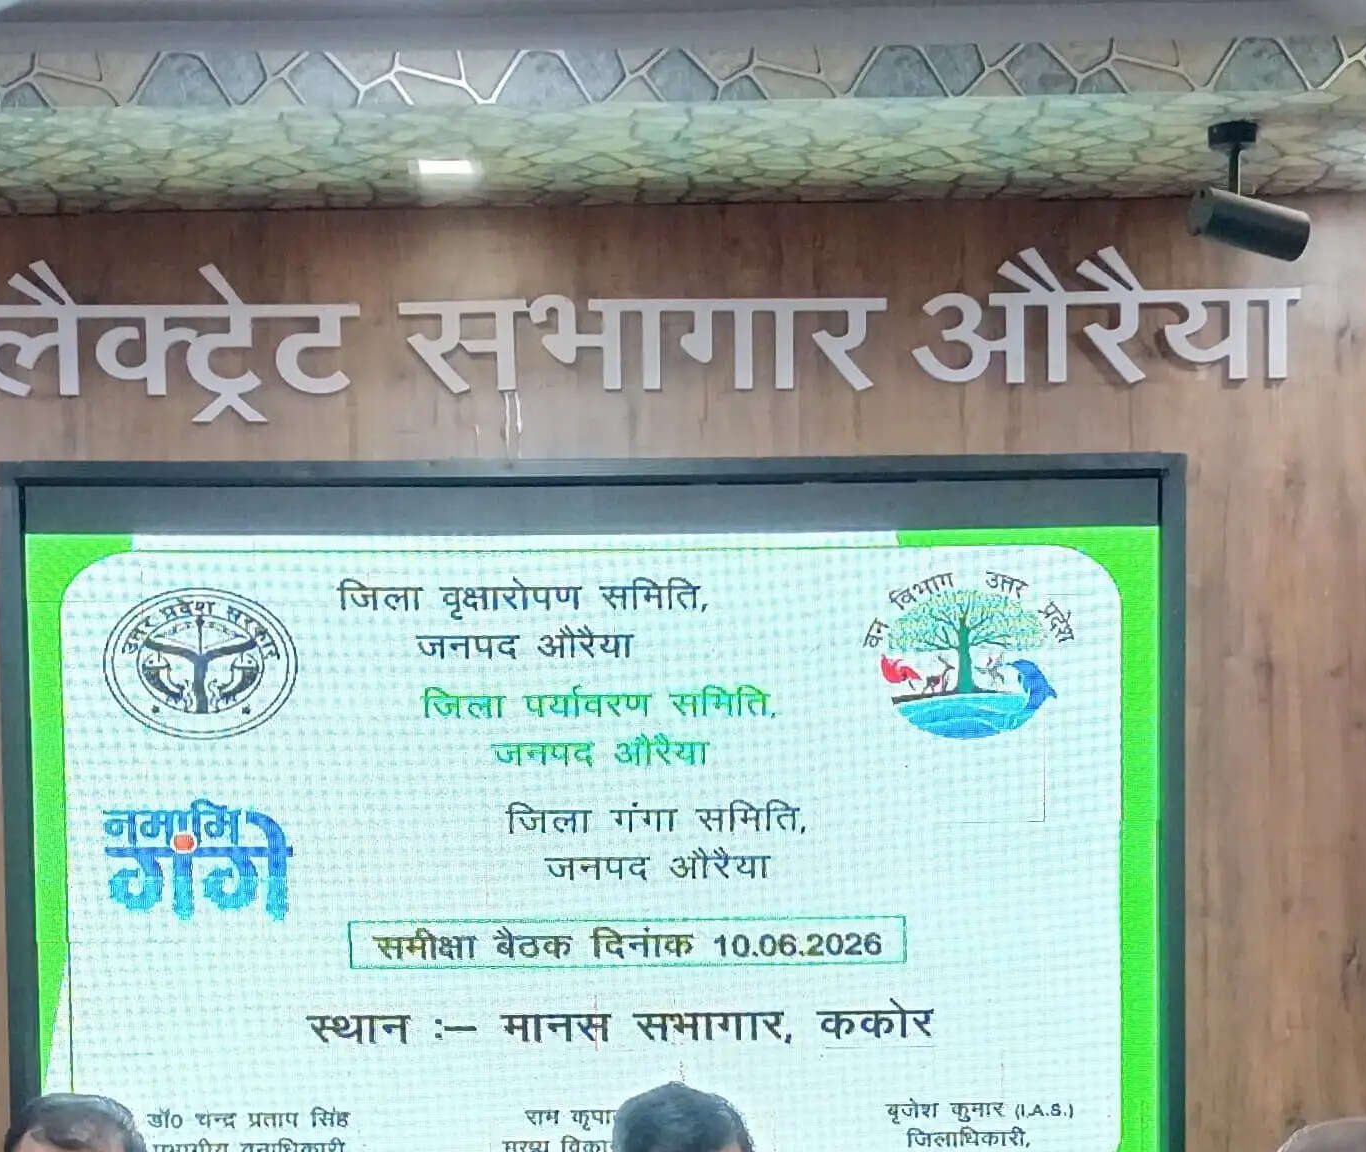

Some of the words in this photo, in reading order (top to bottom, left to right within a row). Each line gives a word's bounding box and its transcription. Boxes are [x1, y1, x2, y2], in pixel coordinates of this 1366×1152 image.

[397, 291, 888, 395] सभागार
[911, 245, 1303, 386] औरैया
[337, 577, 423, 612] जिला
[439, 576, 583, 621] वृक्षारोपण
[598, 576, 708, 614] समिति,
[888, 572, 954, 611] विभाग
[416, 633, 521, 660] जनपद
[536, 624, 635, 660] औरैया
[420, 686, 507, 719] जिला
[522, 684, 653, 719] पर्यावरण
[668, 684, 777, 720] समिति,
[490, 741, 596, 768] जनपद
[613, 732, 710, 767] औरैया
[102, 798, 242, 846] नमामि
[505, 801, 593, 835] जिला
[609, 801, 679, 834] गंगा
[694, 798, 806, 835] समिति,
[544, 856, 651, 881] जनपद
[669, 846, 772, 880] औरैया
[372, 926, 477, 960] समीक्षा
[492, 925, 573, 960] बैठक
[588, 925, 695, 959] दिनांक
[713, 931, 884, 959] 10.06.2026
[306, 1013, 411, 1045] स्थान
[500, 1010, 612, 1044] मानस
[633, 1009, 794, 1046] सभागार,
[816, 997, 937, 1041] ककोर
[247, 1111, 299, 1129] प्रताप
[310, 1105, 352, 1128] सिंह
[524, 1109, 560, 1126] राम
[570, 1109, 617, 1132] कृपा
[949, 1101, 1006, 1123] कुमार
[906, 1125, 1031, 1149] जिलाधिकारी,
